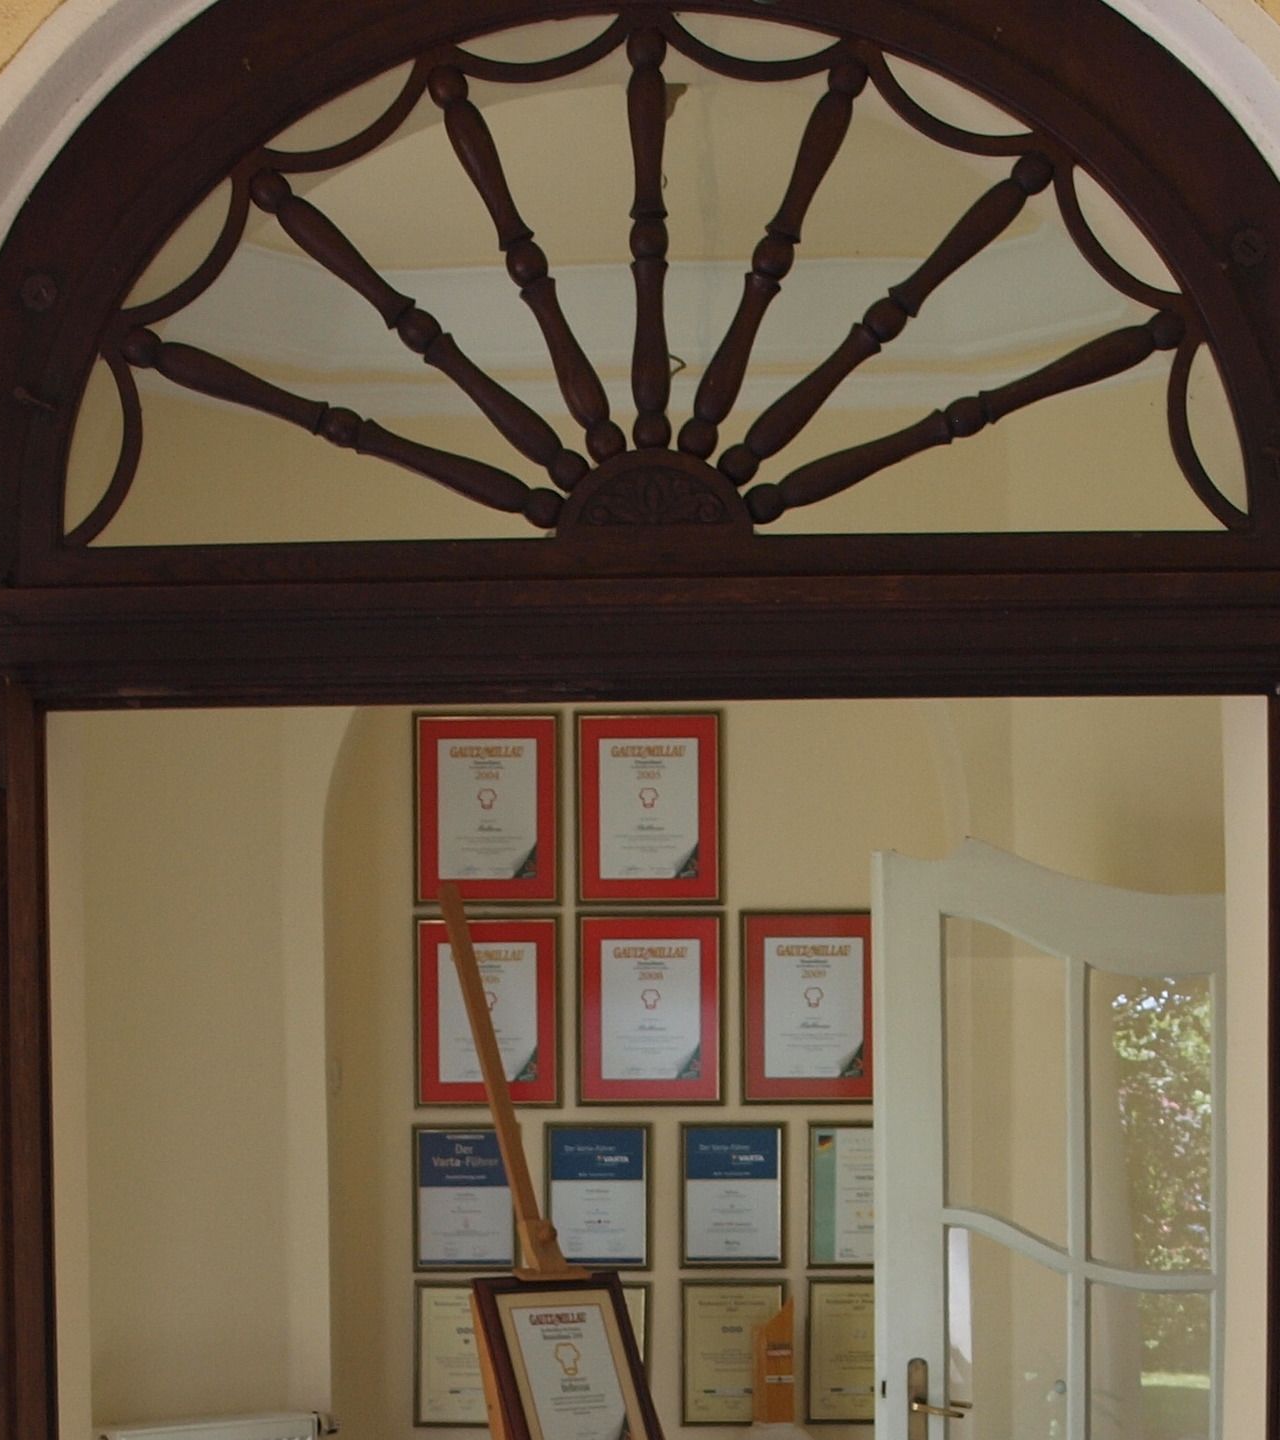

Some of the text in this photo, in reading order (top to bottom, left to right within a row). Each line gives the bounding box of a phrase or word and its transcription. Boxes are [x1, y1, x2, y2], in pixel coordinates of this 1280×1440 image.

[455, 1143, 473, 1154] Der
[603, 1155, 630, 1163] VARTA
[738, 1153, 766, 1162] VARTA
